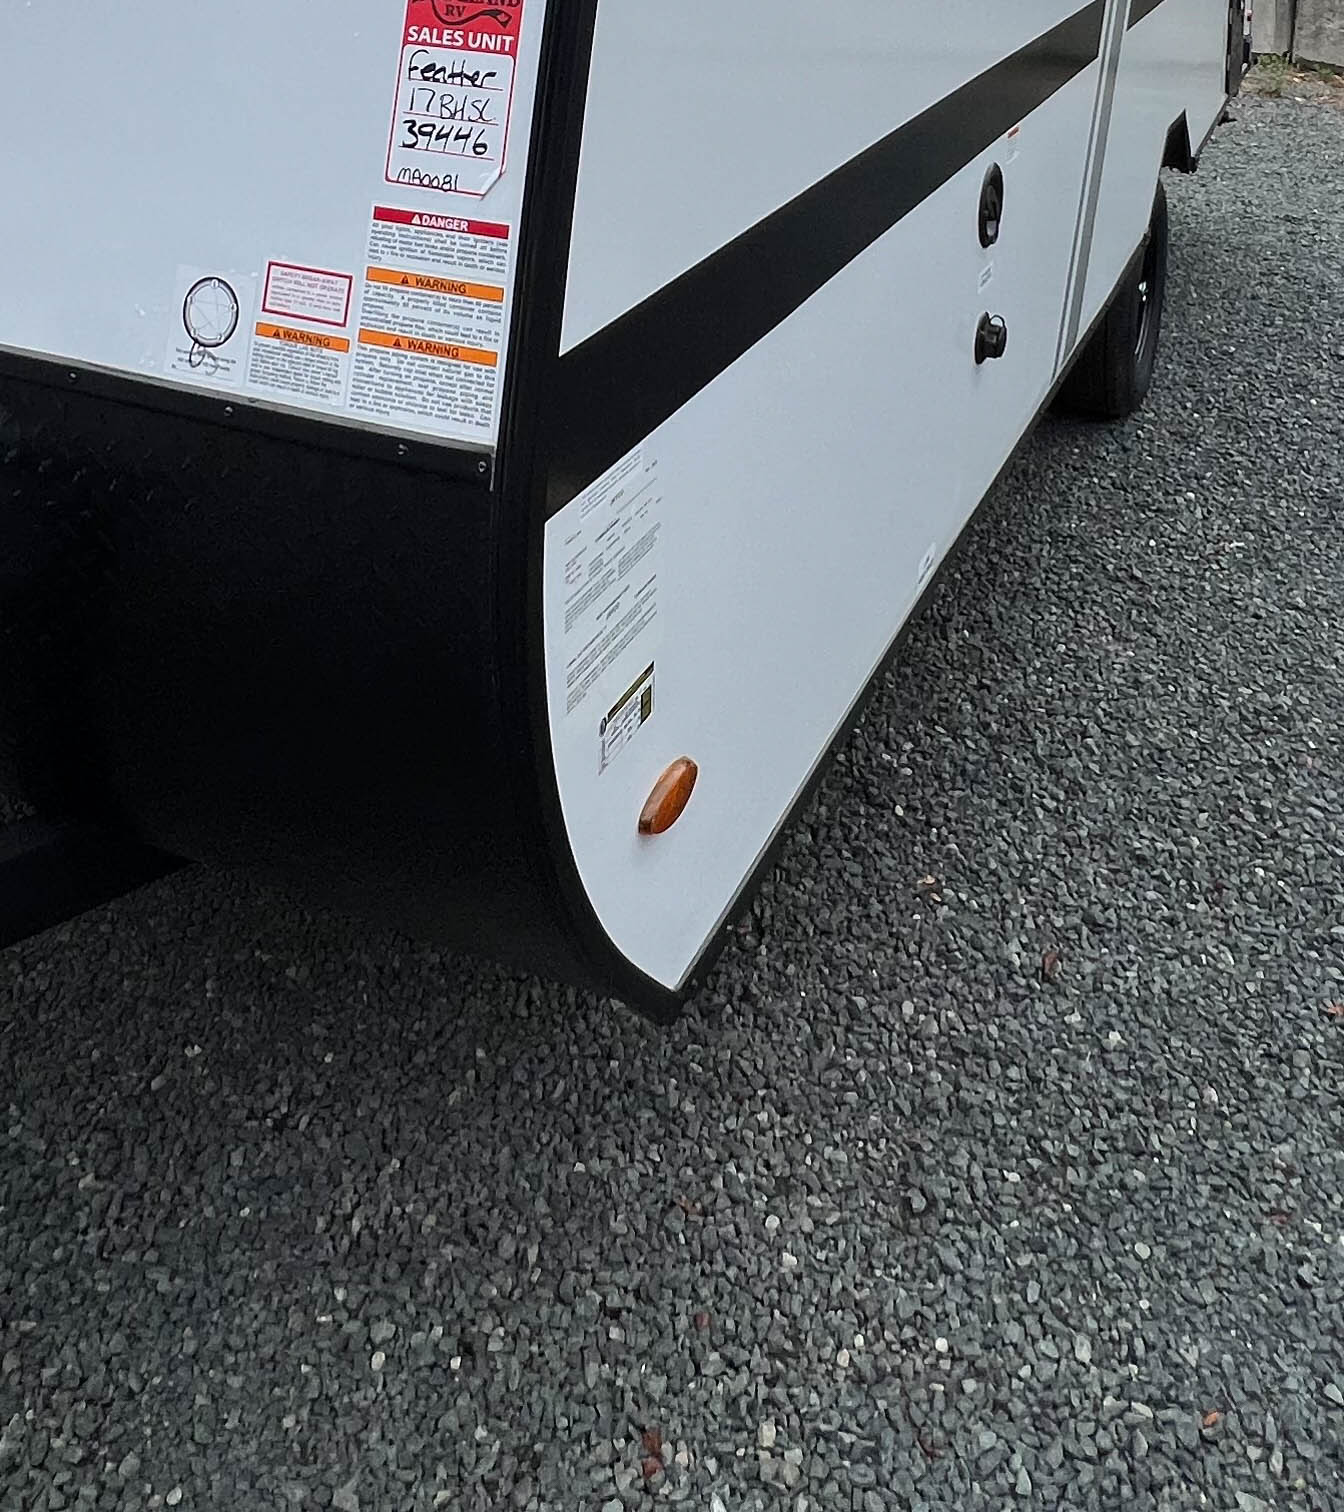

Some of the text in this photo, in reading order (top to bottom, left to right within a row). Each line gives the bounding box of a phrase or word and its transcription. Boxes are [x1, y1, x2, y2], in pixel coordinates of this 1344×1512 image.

[444, 4, 467, 18] RV
[407, 26, 515, 52] SALES UNIT
[402, 119, 488, 156] 39446
[421, 214, 469, 232] DANGER
[415, 276, 467, 294] WARNING
[282, 330, 330, 348] WARNING
[407, 338, 460, 358] WARNING
